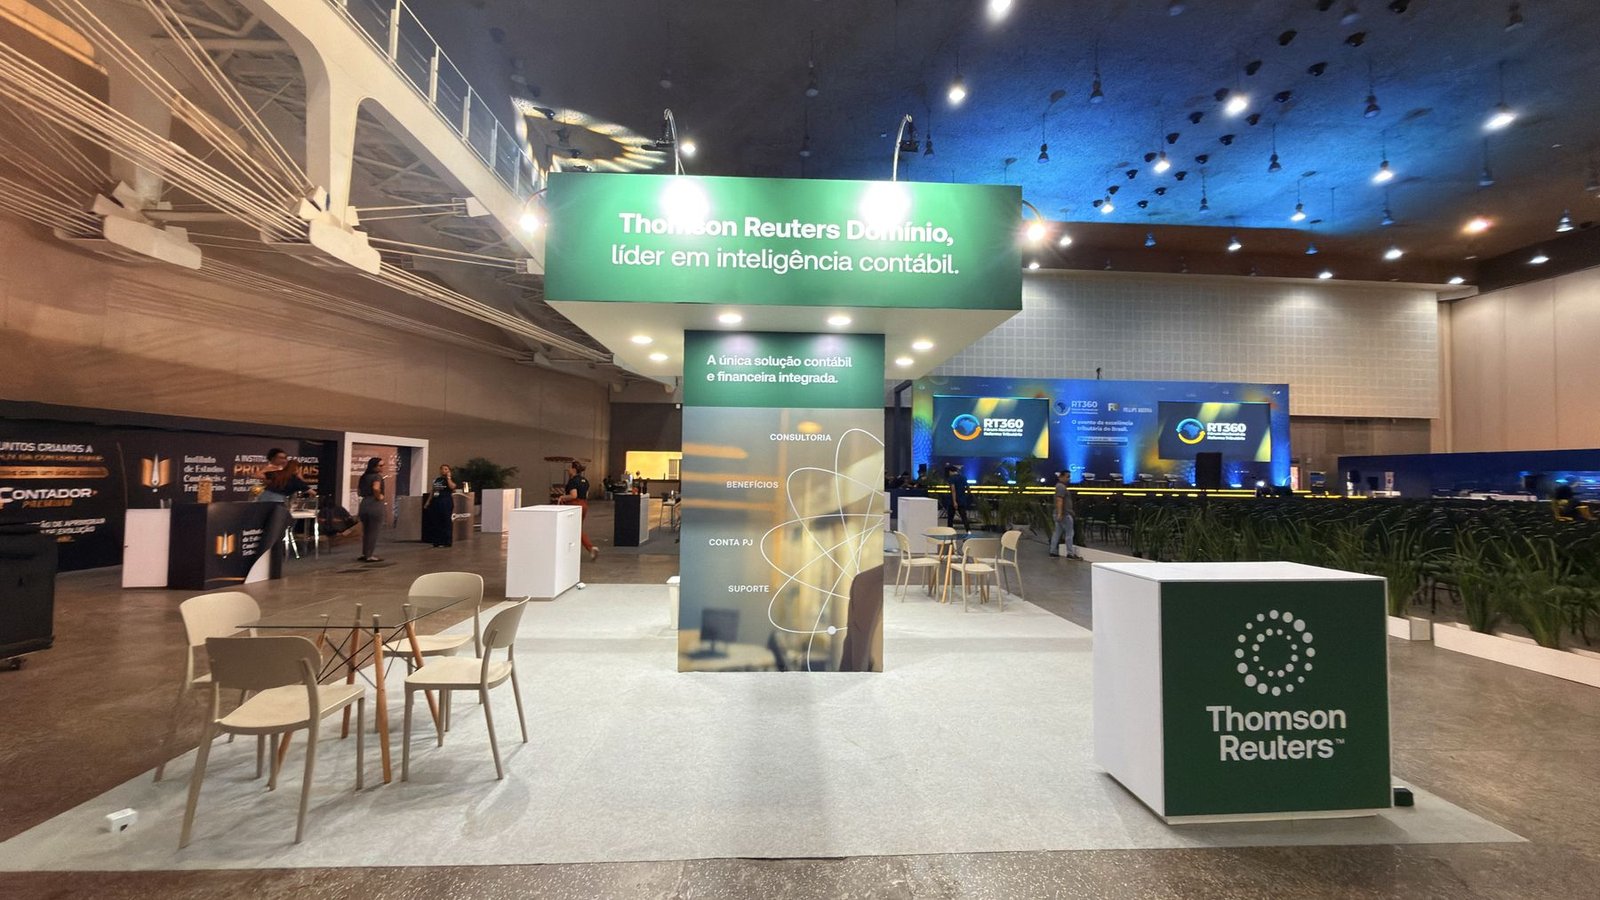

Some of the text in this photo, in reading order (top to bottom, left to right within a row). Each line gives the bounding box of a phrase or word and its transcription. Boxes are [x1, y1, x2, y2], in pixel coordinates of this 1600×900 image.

[744, 216, 840, 239] Reuters
[612, 244, 959, 274] líder em inteligência contábil.
[706, 354, 853, 369] A única solução contábil
[706, 371, 839, 386] e financeira integrada.
[1071, 401, 1098, 409] RT360
[983, 418, 1024, 430] RT360
[1207, 422, 1247, 433] RT360
[769, 433, 832, 442] CONSULTORIA
[86, 445, 93, 453] A
[726, 480, 779, 489] BENEFÍCIOS
[0, 487, 92, 503] CONTADOR
[709, 538, 753, 546] CONTA PJ
[728, 585, 770, 593] SUPORTE
[1206, 705, 1347, 732] Thomson
[1220, 734, 1334, 761] Reuters
